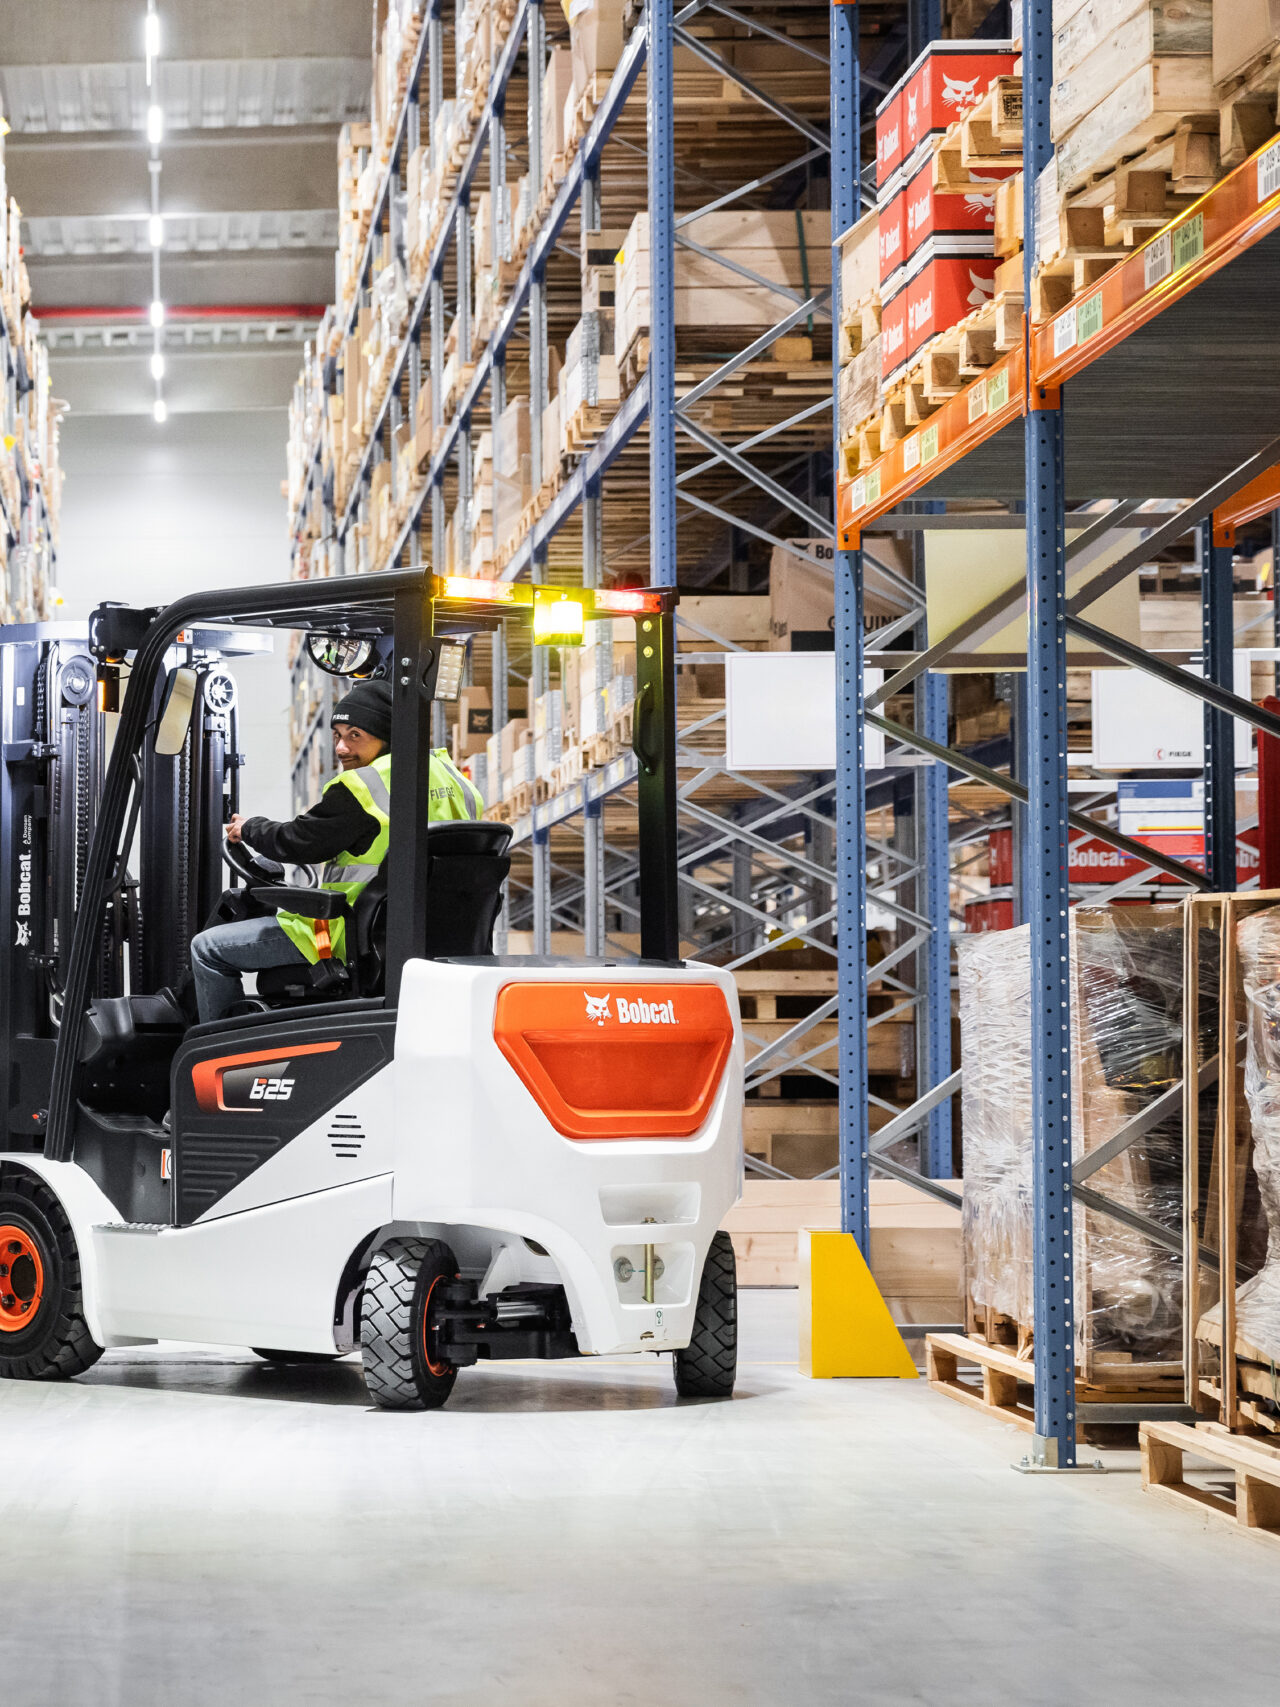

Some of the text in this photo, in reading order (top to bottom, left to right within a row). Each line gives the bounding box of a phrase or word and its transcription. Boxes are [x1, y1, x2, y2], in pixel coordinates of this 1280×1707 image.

[18, 854, 31, 915] Bobcat
[615, 997, 676, 1025] Bobcat
[249, 1077, 296, 1101] B25
